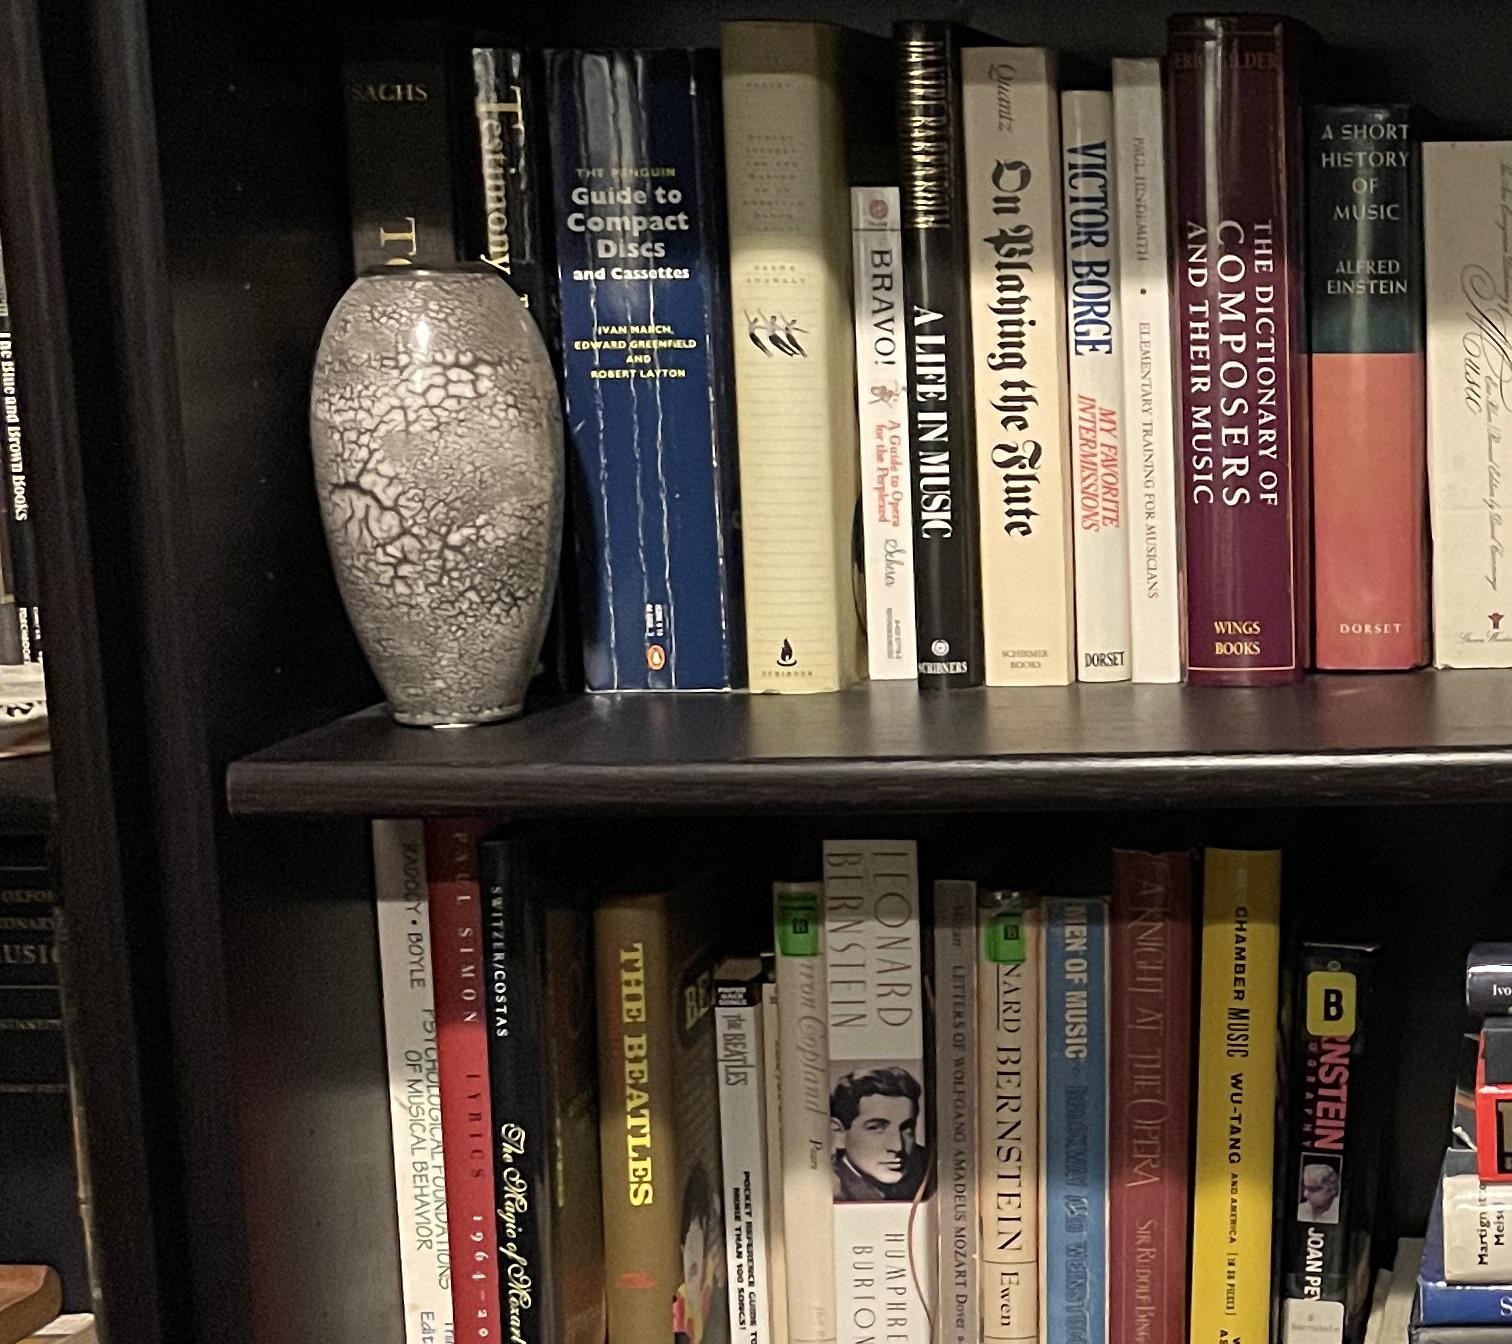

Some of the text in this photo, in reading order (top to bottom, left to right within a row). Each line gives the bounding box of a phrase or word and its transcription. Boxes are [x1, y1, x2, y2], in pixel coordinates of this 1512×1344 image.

[1321, 124, 1409, 141] A SHORT
[1321, 152, 1409, 168] HISTORY
[572, 187, 682, 205] Guide to
[1352, 178, 1378, 194] OF
[567, 211, 690, 236] Compact
[1333, 205, 1400, 221] MUSIC
[597, 239, 665, 258] Discs
[1067, 140, 1113, 357] VICTOR BORGE
[1336, 260, 1400, 275] ALFRED
[573, 267, 690, 281] and Cassettes
[1327, 281, 1408, 295] EINSTEIN
[1188, 220, 1213, 504] AND THEIR MUSIC
[1217, 220, 1250, 506] COMPOSERS
[1254, 219, 1278, 506] THE DICTIONARY OF
[827, 853, 867, 1028] BERNSTEIN
[873, 853, 912, 1027] LEONARD
[1234, 907, 1248, 1001] CHAMBER
[1323, 989, 1344, 1021] B
[1227, 1008, 1250, 1058] MUSIC
[620, 942, 653, 1206] THE BEATLES
[1229, 1073, 1243, 1164] WU-TANG
[996, 1047, 1022, 1251] BERNSTEIN
[1304, 1227, 1325, 1272] JOAN
